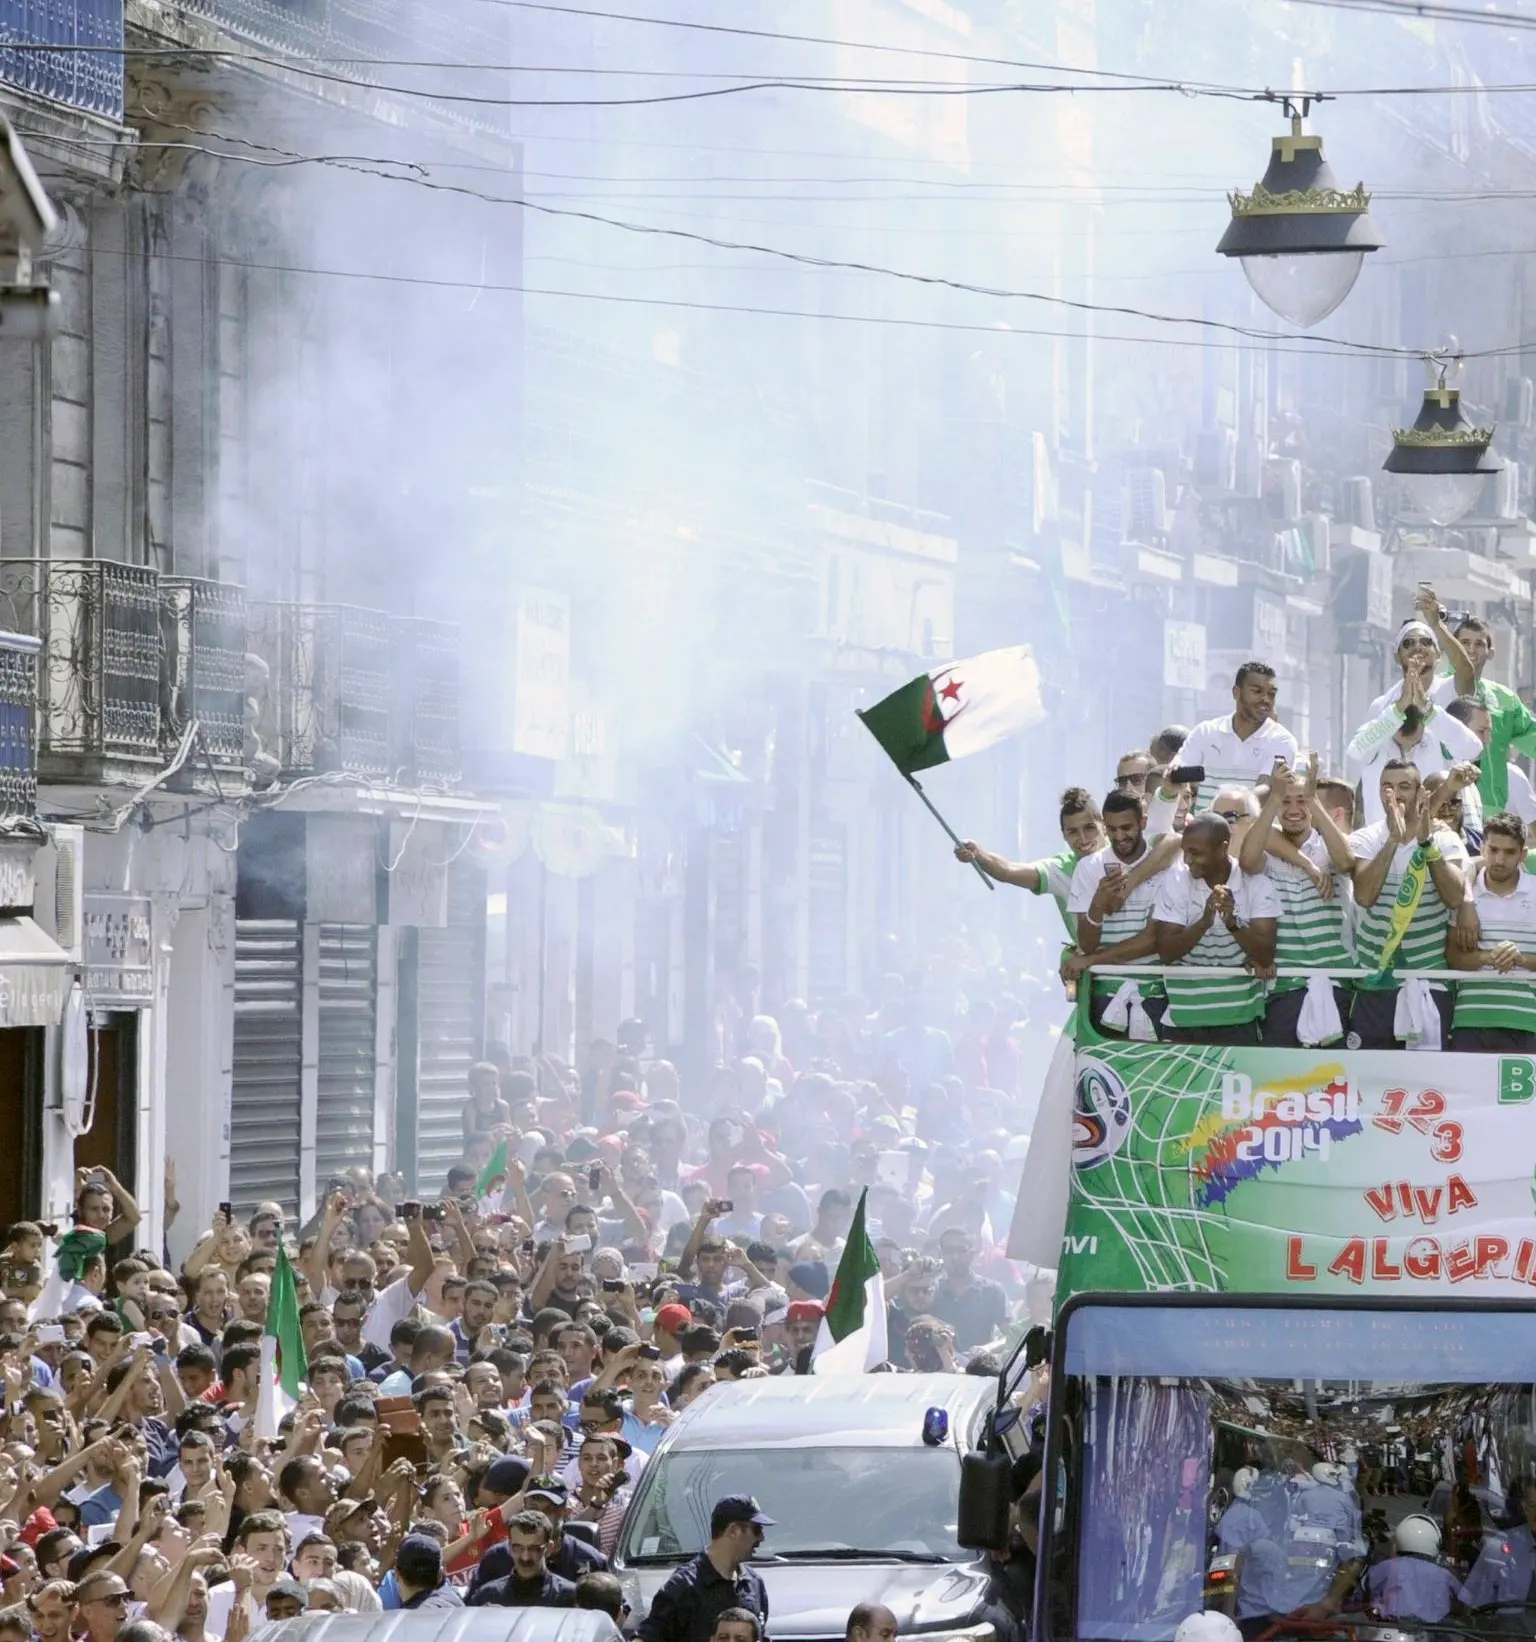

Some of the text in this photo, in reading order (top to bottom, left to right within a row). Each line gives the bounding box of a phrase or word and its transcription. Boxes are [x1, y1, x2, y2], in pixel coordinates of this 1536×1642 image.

[1221, 1070, 1359, 1122] Brasil
[1236, 1126, 1330, 1162] 2014
[1431, 1119, 1464, 1163] 3
[1364, 1172, 1478, 1224] VIVA
